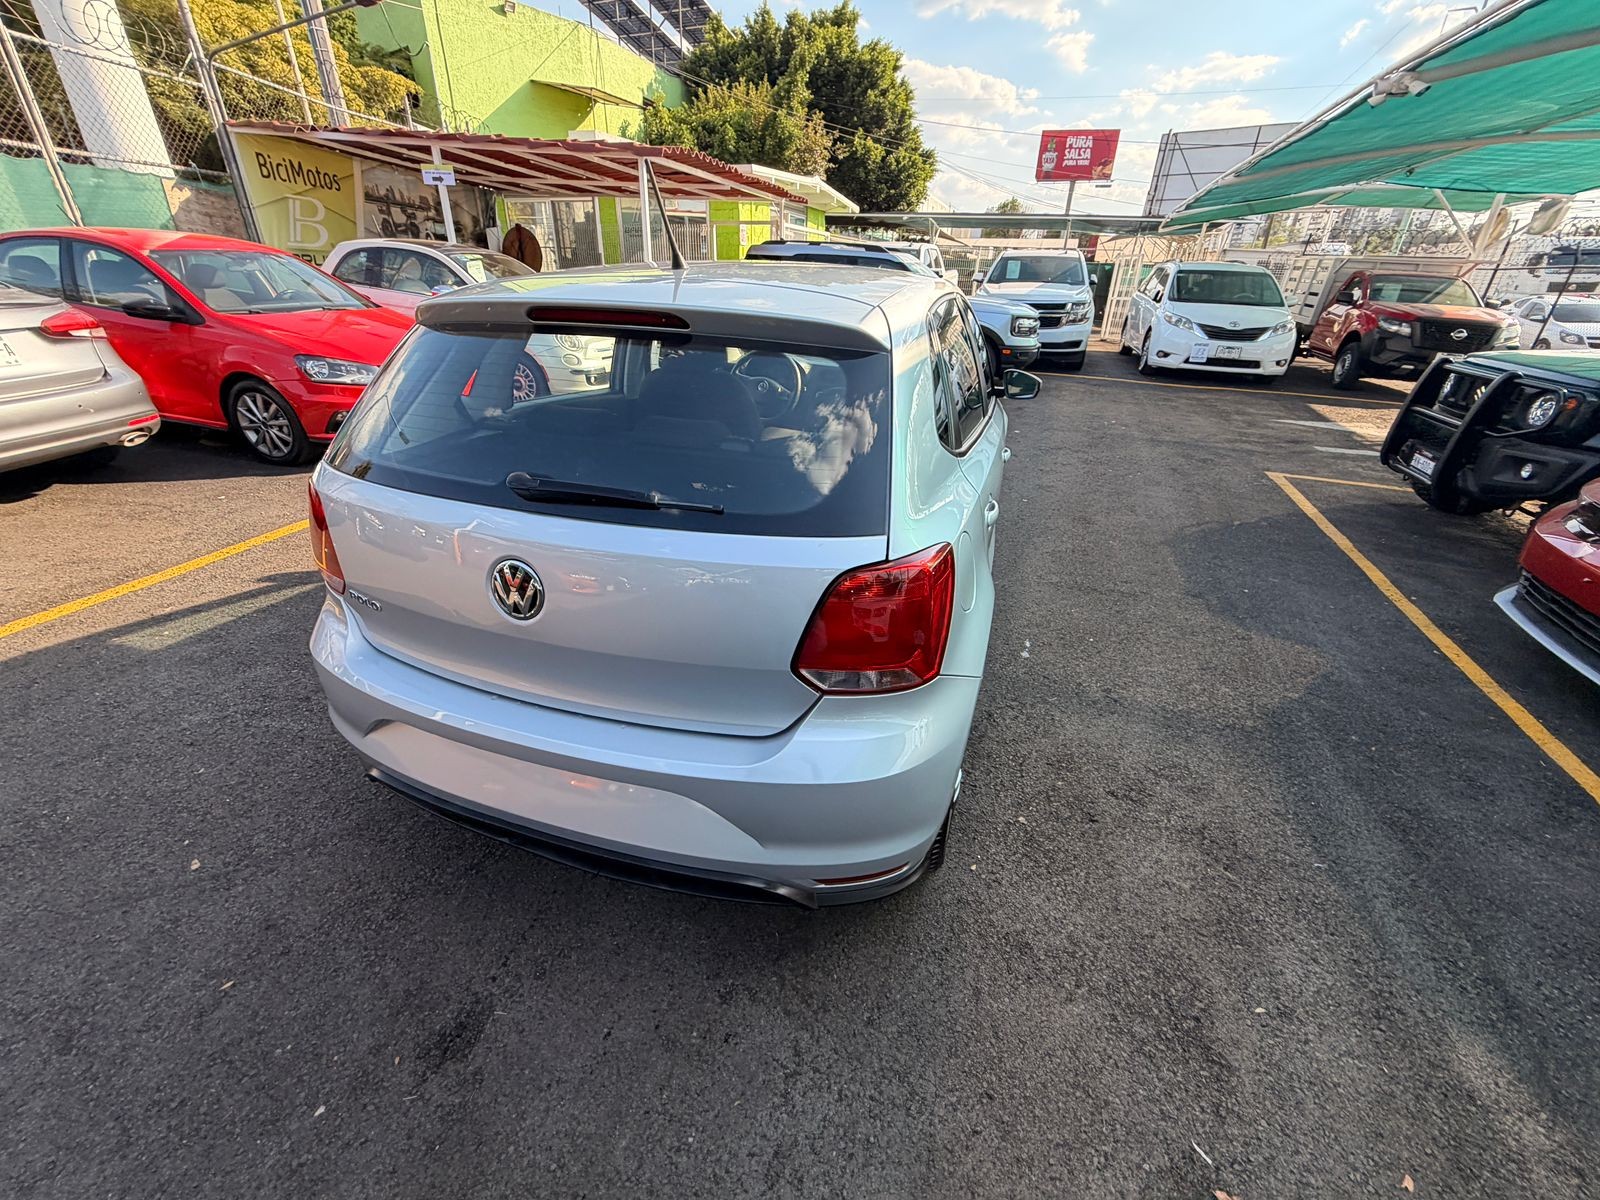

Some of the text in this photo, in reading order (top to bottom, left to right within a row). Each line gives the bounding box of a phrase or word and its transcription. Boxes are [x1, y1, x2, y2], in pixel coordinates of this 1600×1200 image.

[1065, 135, 1093, 148] PURA
[1063, 148, 1091, 160] SALSA
[255, 151, 341, 192] BiciMotos
[287, 194, 328, 248] B
[348, 589, 382, 612] POLO
